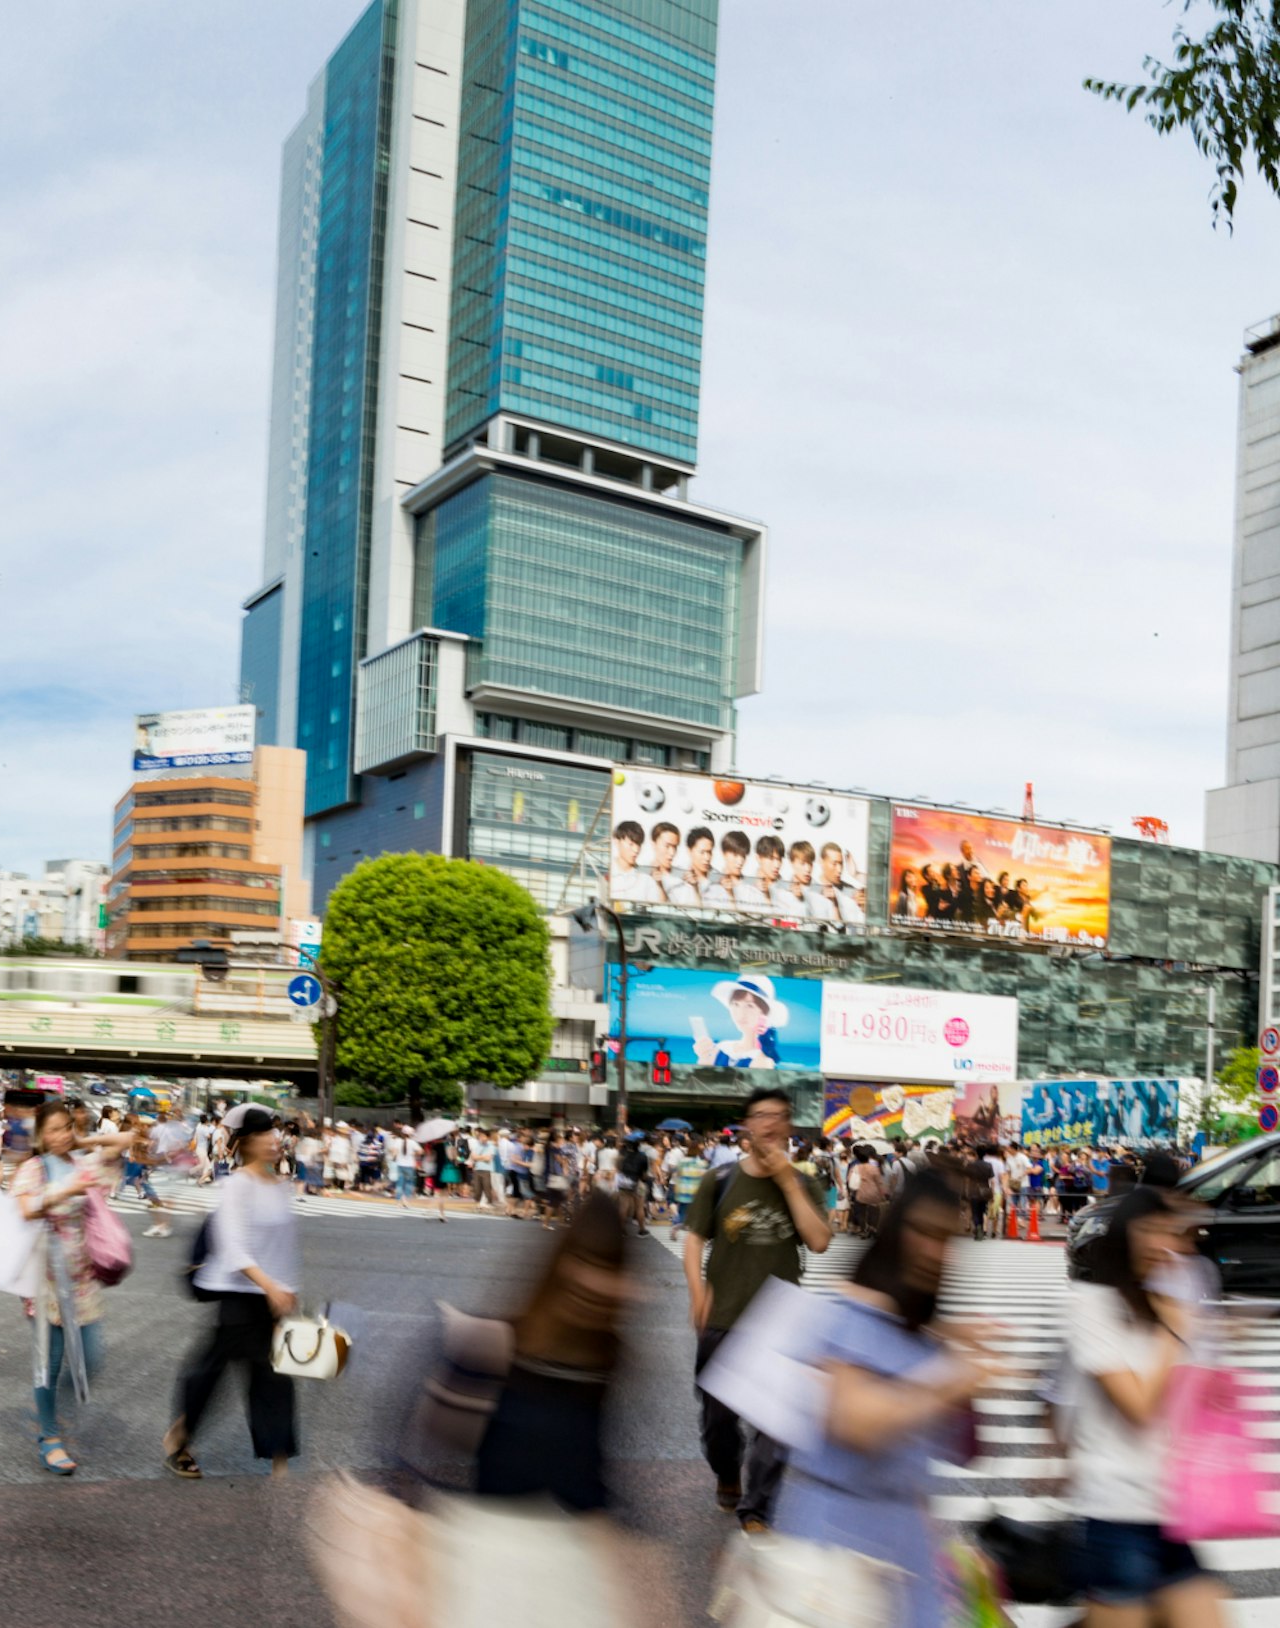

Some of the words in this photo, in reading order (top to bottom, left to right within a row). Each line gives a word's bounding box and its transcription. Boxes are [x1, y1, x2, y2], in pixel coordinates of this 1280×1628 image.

[624, 927, 662, 954] JR
[668, 932, 740, 960] 渋谷駅
